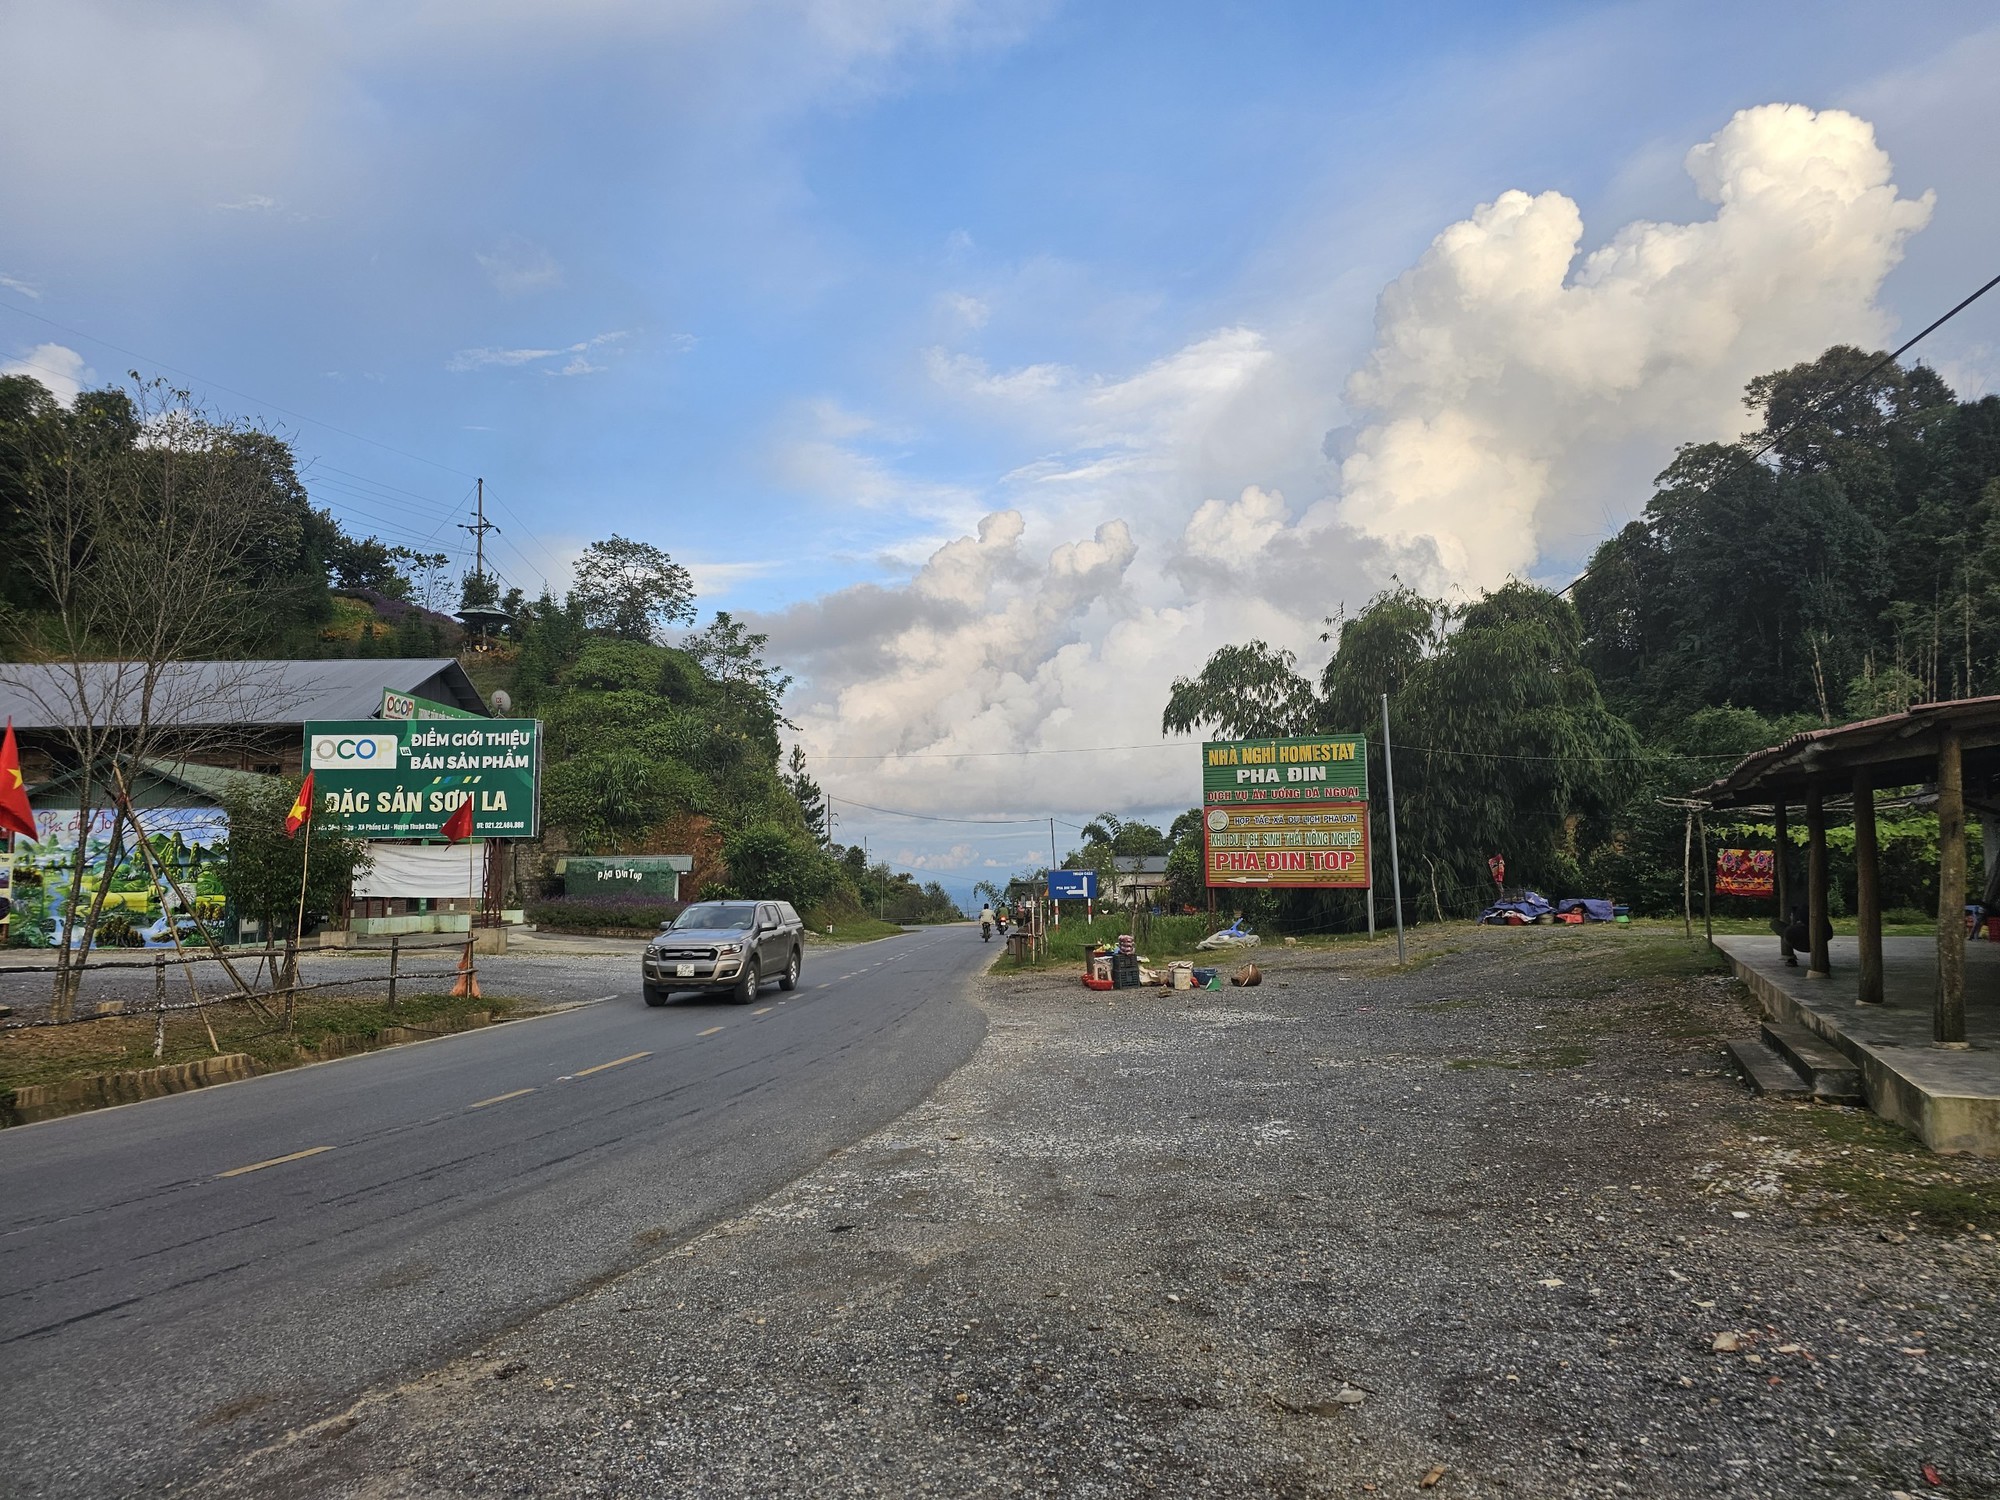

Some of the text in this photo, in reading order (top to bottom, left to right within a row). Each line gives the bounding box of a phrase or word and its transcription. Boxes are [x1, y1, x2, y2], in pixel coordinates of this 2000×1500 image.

[387, 696, 413, 716] OCOP
[411, 727, 530, 749] ĐIỂM GIỚI THIỆU
[316, 739, 393, 759] OCOP
[410, 749, 529, 769] BÁN SẢN PHẨM
[1208, 741, 1356, 766] NHÀ NGHỈ HOMESTAY
[1236, 766, 1326, 784] PHA ĐIN
[377, 785, 423, 812] SẢN
[481, 791, 508, 811] LA
[1207, 790, 1231, 802] DỊCH
[1235, 791, 1248, 802] VỤ
[1271, 787, 1300, 799] UỐNG
[1324, 787, 1359, 799] NGOẠI
[1323, 814, 1341, 823] PHA
[1342, 813, 1358, 823] ĐIN
[1211, 833, 1227, 846] KHU
[1262, 832, 1282, 846] SINH
[1305, 828, 1329, 846] NÔNG
[1331, 827, 1362, 850] NGHIỆP
[1214, 851, 1356, 871] PHA ĐIN TOP
